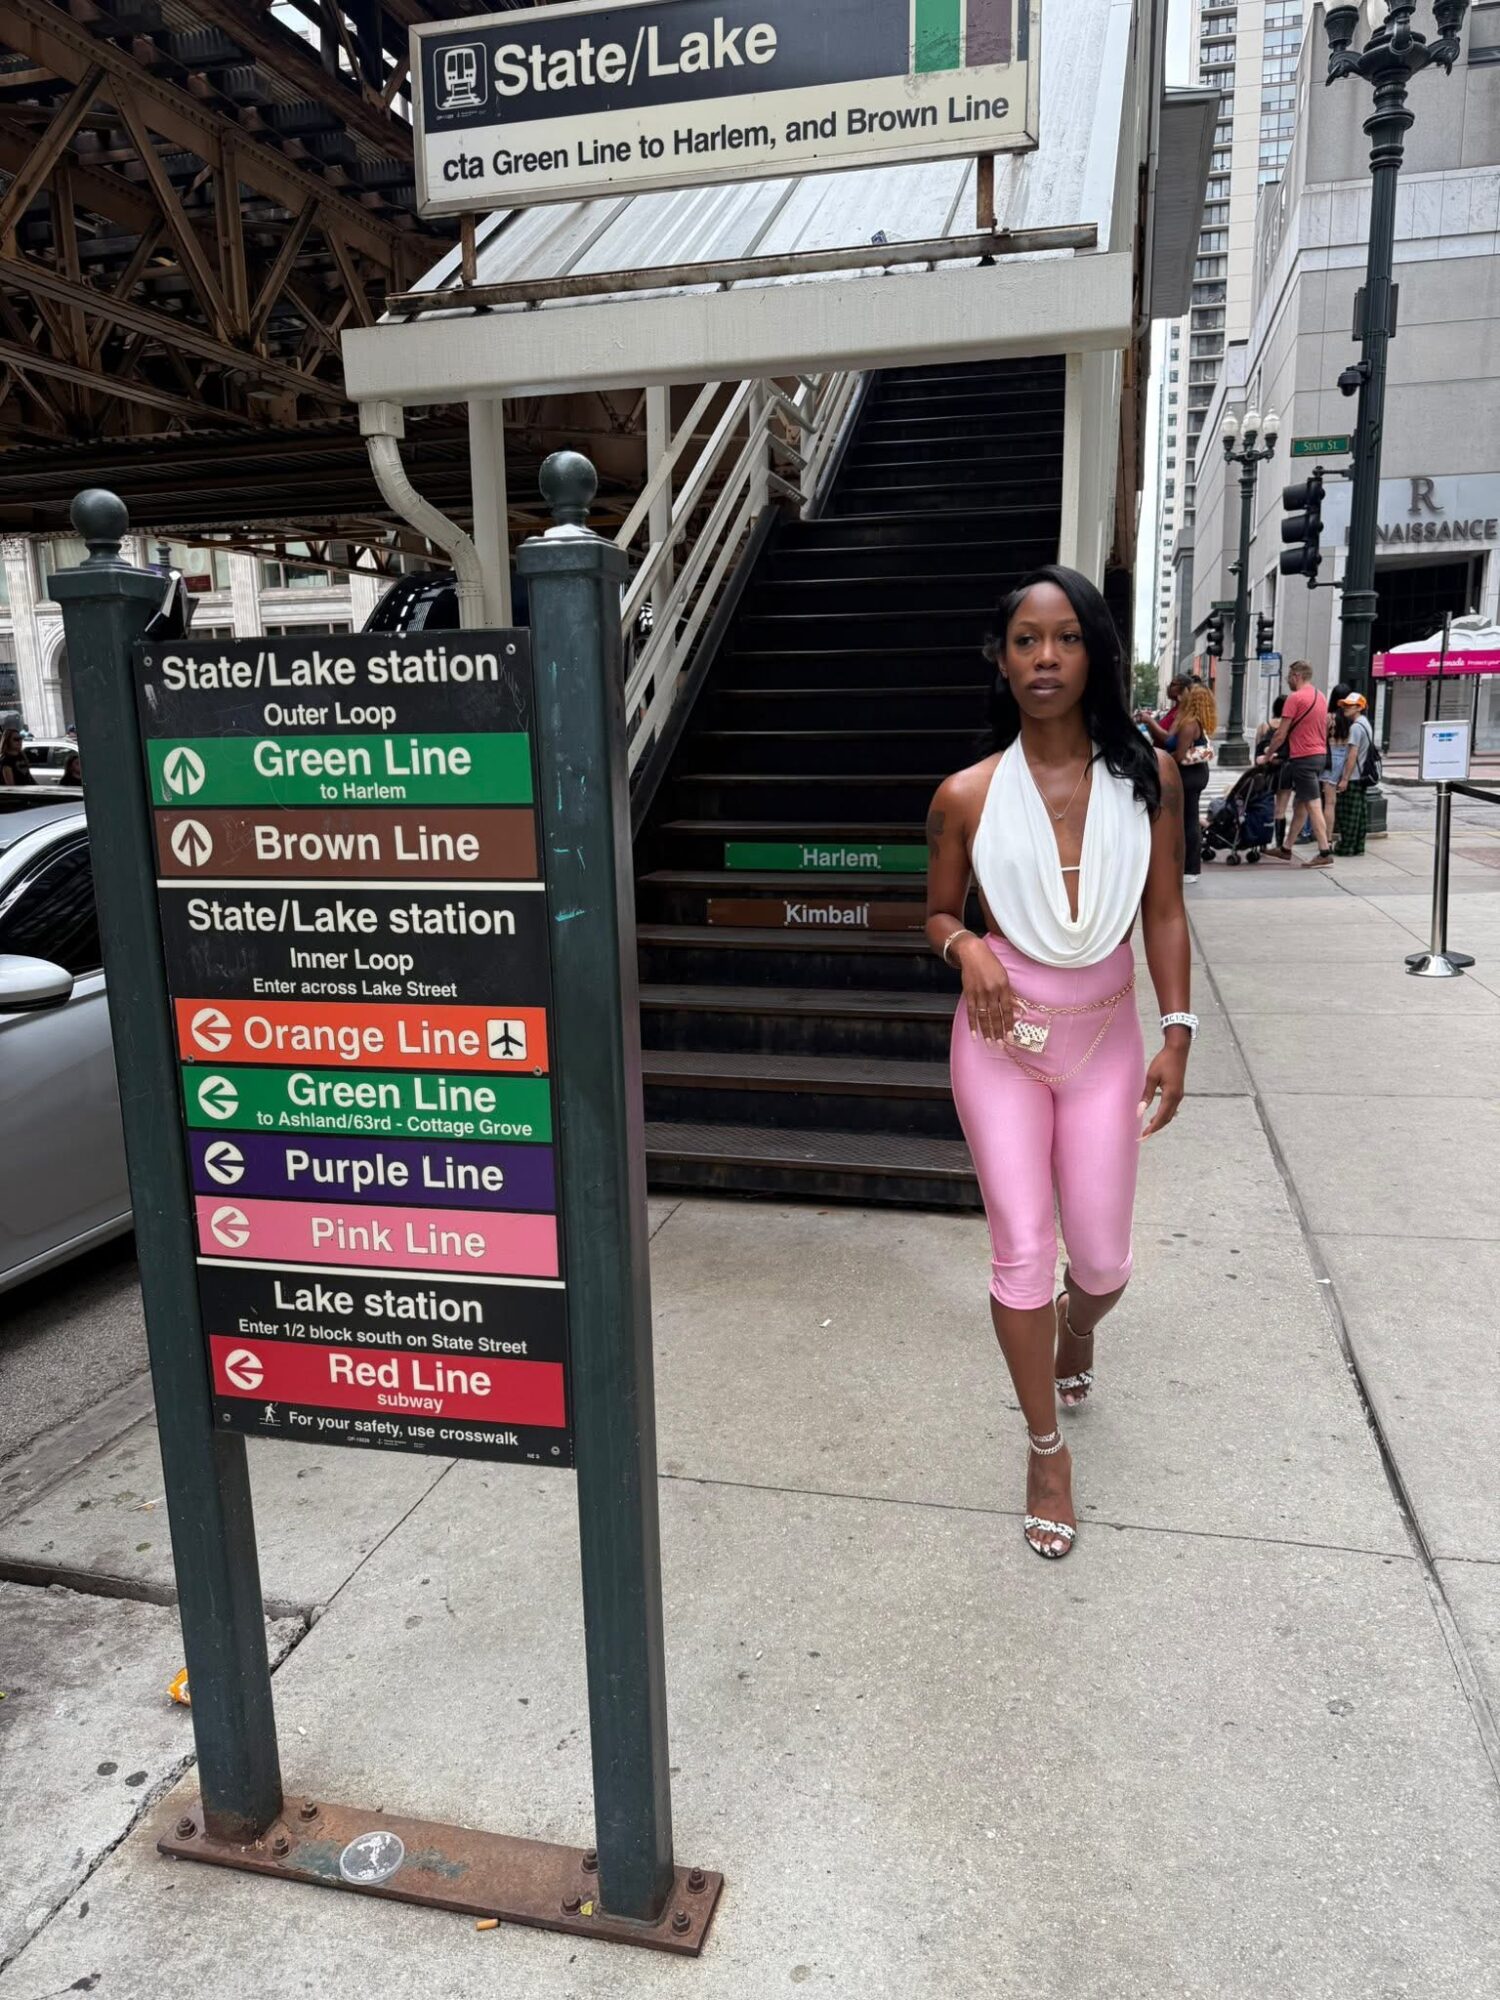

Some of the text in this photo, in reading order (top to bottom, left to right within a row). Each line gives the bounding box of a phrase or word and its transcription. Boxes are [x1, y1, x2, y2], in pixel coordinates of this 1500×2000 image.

[494, 16, 777, 97] State/Lake
[442, 93, 1009, 182] cta Green Line to Harlem, and Brown Line
[1408, 477, 1444, 514] R
[1345, 518, 1498, 546] NAISSANCE
[162, 647, 498, 690] State/Lake station
[264, 703, 396, 729] Outer Loop
[253, 739, 471, 777] Green Line
[320, 783, 406, 799] to Harlem
[255, 826, 479, 861] Brown Line
[802, 847, 877, 868] Harlem
[188, 899, 515, 935] State/Lake station
[786, 904, 867, 925] Kimball
[290, 947, 413, 975] Inner Loop
[253, 979, 457, 998] Enter across Lake Street
[243, 1015, 481, 1060] Orange Line
[287, 1073, 497, 1113] Green Line
[257, 1111, 274, 1126] to
[278, 1111, 392, 1131] Ashland/63rd
[408, 1117, 474, 1136] Cottage
[479, 1121, 532, 1136] Grove
[286, 1150, 504, 1192] Purple Line
[311, 1217, 487, 1258] Pink Line
[275, 1281, 483, 1323] Lake station
[239, 1318, 527, 1354] Enter 1/2 block south on State Street
[329, 1353, 492, 1396] Red Line
[378, 1393, 443, 1413] subway
[289, 1412, 518, 1446] For your safety, use crosswalk
